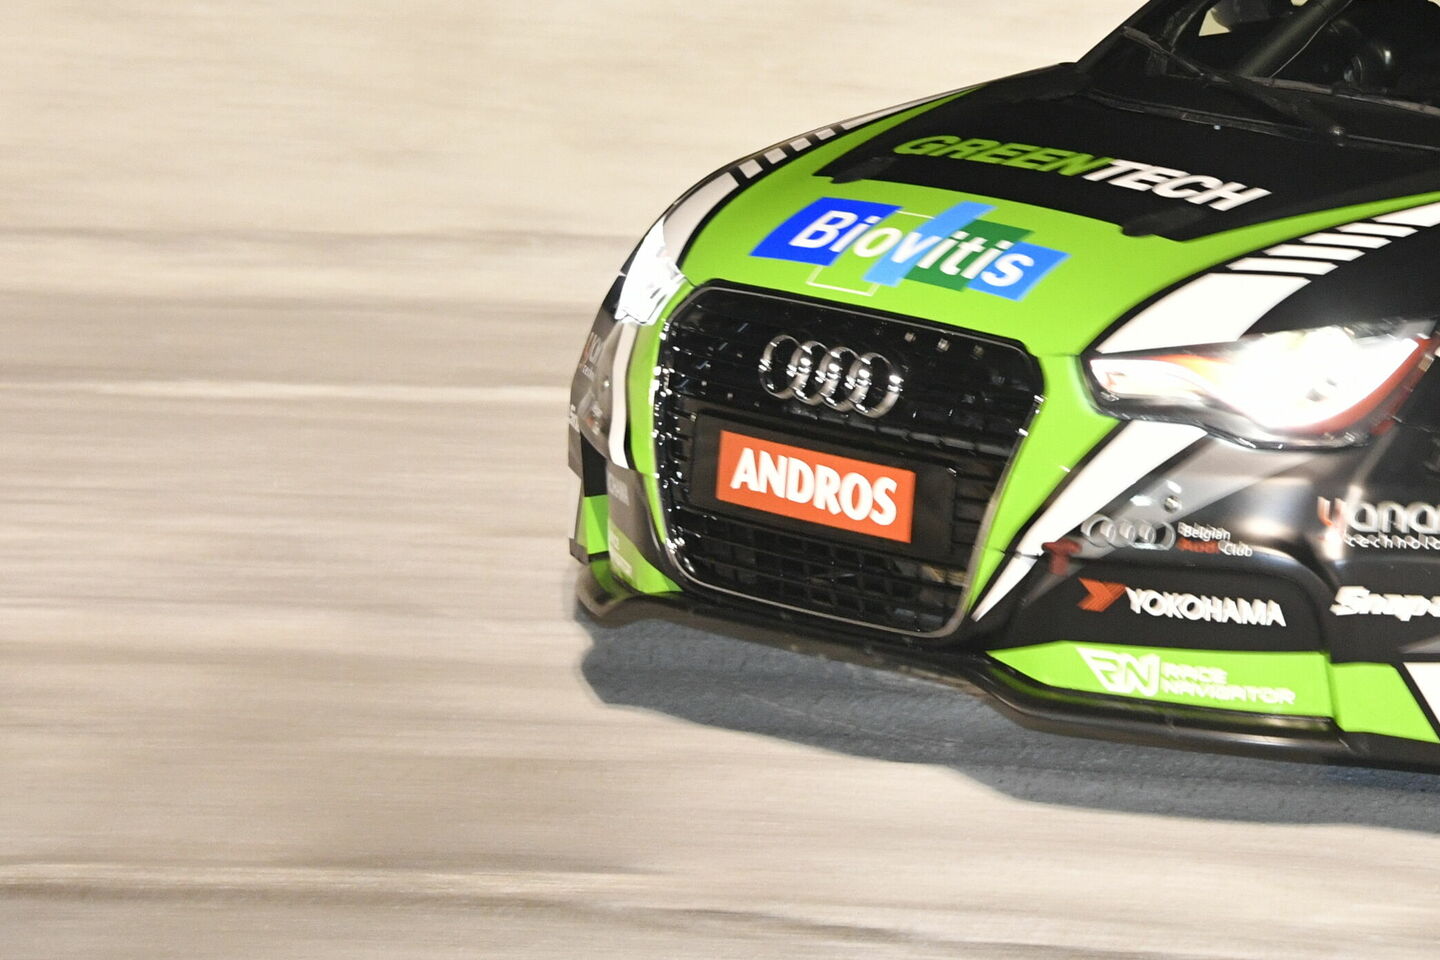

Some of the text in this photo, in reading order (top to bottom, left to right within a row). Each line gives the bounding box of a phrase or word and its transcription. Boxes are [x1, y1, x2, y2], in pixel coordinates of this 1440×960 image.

[892, 135, 1273, 212] GREENTECH
[788, 208, 1036, 288] Biovitis
[730, 447, 897, 526] ANDROS
[1178, 521, 1231, 542] Belgian
[1218, 540, 1253, 557] Club
[1125, 585, 1287, 627] YOKOHAMA
